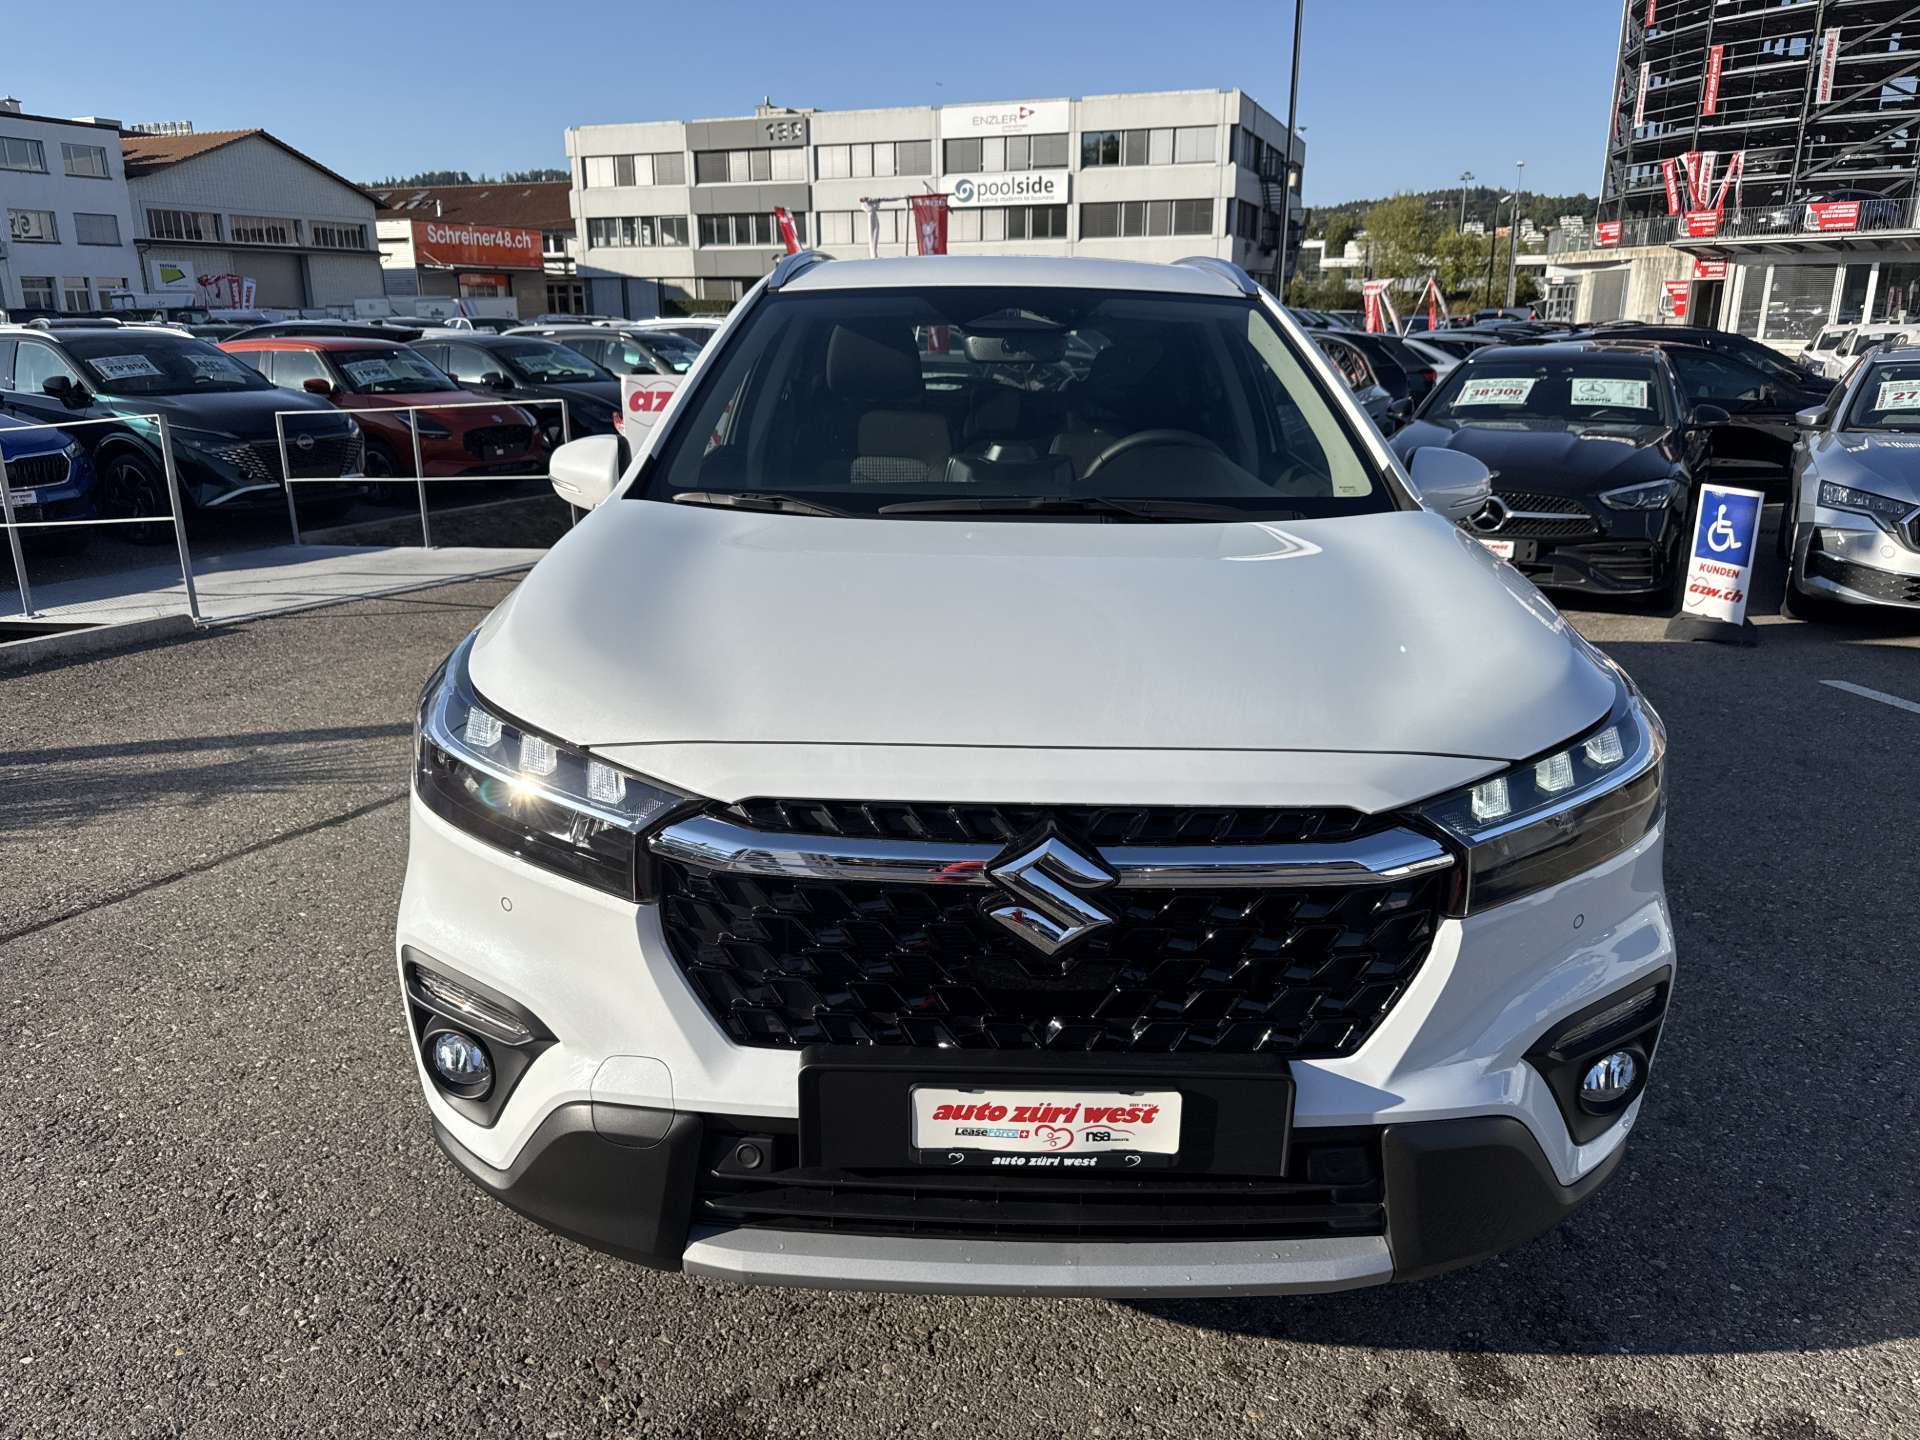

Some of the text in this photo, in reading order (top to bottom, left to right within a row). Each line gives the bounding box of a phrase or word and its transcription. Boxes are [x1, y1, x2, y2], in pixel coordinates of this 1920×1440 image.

[972, 114, 1017, 126] ENZLER
[765, 122, 802, 141] 139
[977, 175, 1055, 203] poolside
[427, 224, 532, 249] Schreiner48.ch
[1699, 563, 1740, 579] KUNDEN
[1689, 583, 1744, 603] azw.ch
[932, 1102, 1160, 1124] auto züri west
[1085, 1131, 1111, 1142] nsa
[991, 1155, 1098, 1167] auto züri west
